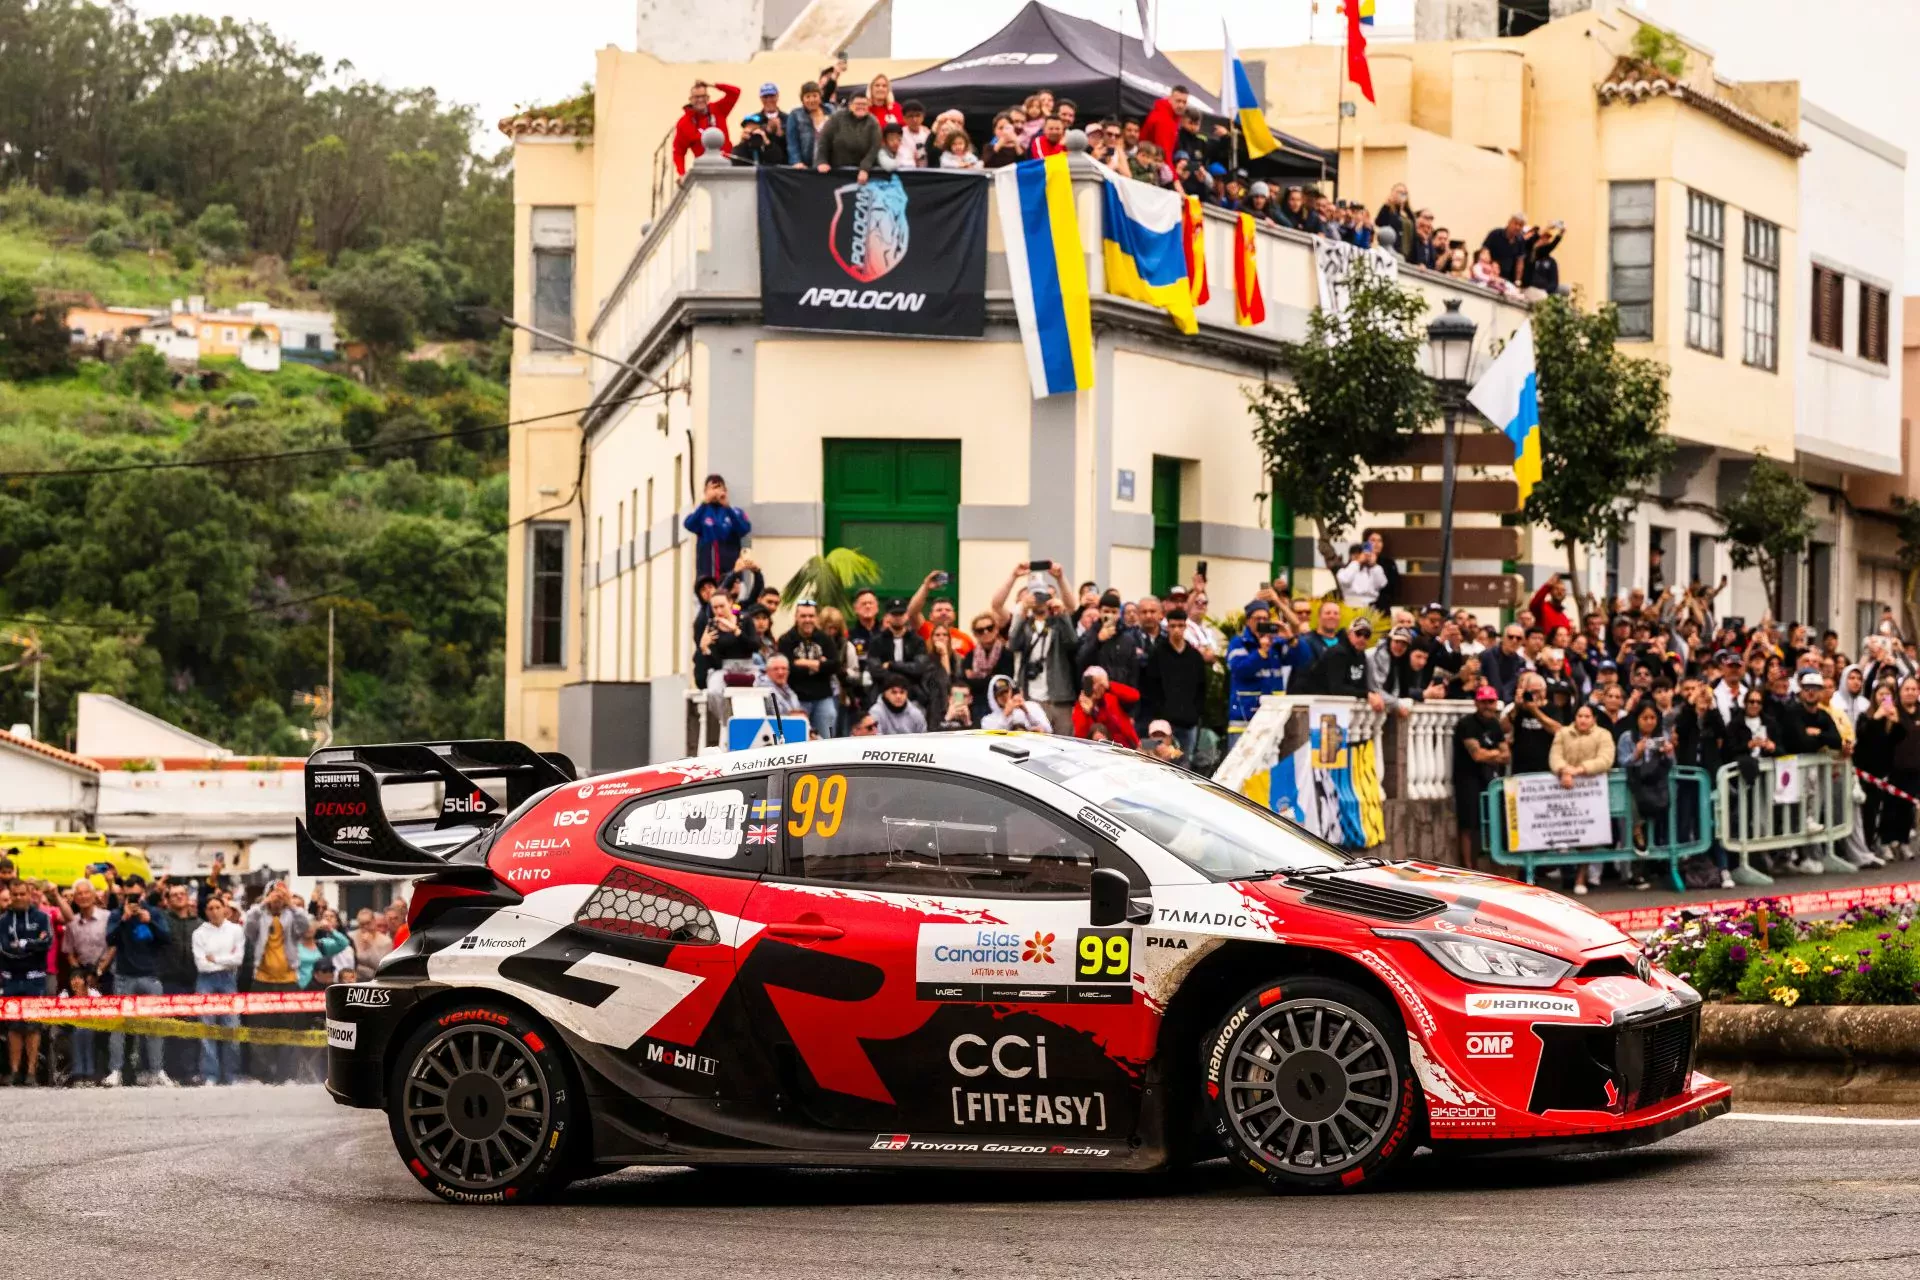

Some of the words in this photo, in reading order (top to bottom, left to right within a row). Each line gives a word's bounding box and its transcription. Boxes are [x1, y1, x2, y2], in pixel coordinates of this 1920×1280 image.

[798, 287, 926, 312] APOLOCAN
[862, 750, 936, 764] PROTERIAL
[596, 787, 643, 796] AIRLINES
[597, 782, 629, 790] JAPAN
[314, 801, 367, 816] DENSO
[444, 789, 487, 813] Stilo
[788, 774, 848, 838] 99
[679, 800, 748, 821] Solberg
[1078, 807, 1122, 839] CENTRAL
[336, 826, 373, 840] SWS
[640, 824, 744, 845] Edmondson
[1157, 909, 1247, 928] TAMADIC
[478, 937, 527, 949] Microsoft
[977, 931, 1020, 947] Islas
[1146, 936, 1189, 949] PIAA
[1462, 925, 1560, 953] codebeamer
[935, 945, 1020, 963] Canarias
[1079, 935, 1130, 975] 99
[346, 987, 391, 1004] ENDLESS
[935, 988, 963, 996] WRC
[1351, 951, 1434, 1039] AUTOMOTIVE
[1361, 949, 1437, 1031] Panasonic
[1466, 1036, 1514, 1054] OMP
[647, 1043, 697, 1071] Mobil
[1430, 1107, 1496, 1117] akebono
[910, 1141, 979, 1151] TOYOTA
[982, 1143, 1048, 1154] GAZOO
[1049, 1145, 1110, 1157] Racing
